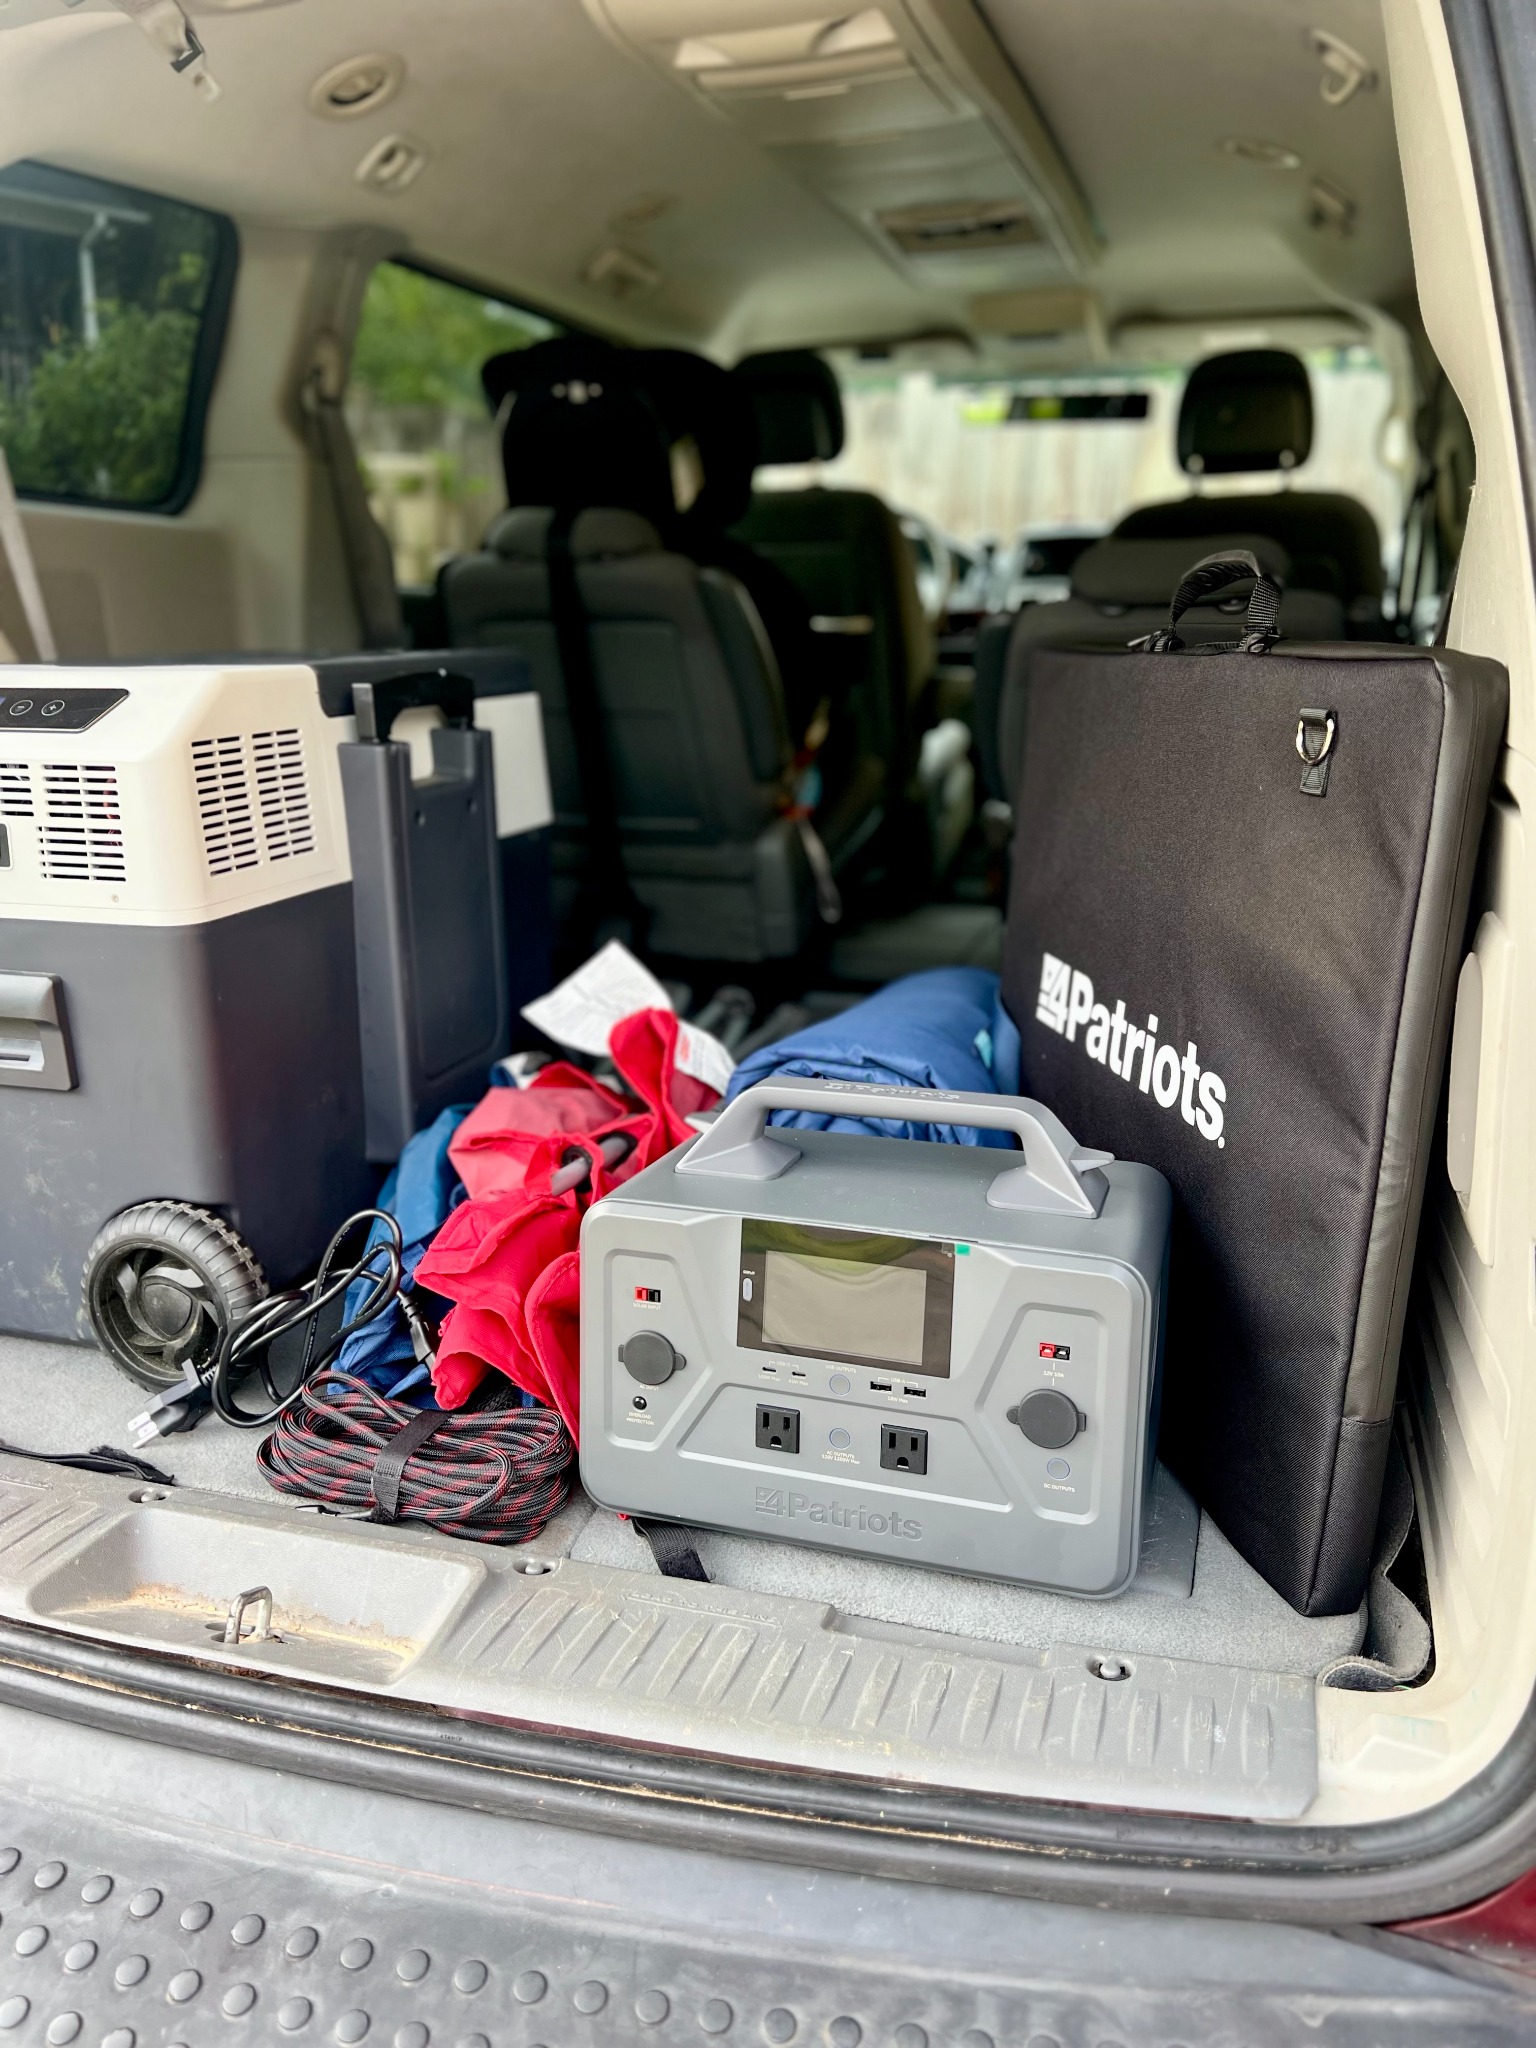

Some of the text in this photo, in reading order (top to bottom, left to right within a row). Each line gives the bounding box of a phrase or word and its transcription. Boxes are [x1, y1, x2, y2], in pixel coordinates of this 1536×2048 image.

[628, 1411, 652, 1420] OVERLOAD
[626, 1417, 655, 1426] PROTECTION
[1051, 1484, 1076, 1493] OUTPUTS
[755, 1486, 923, 1541] 4Patriots
